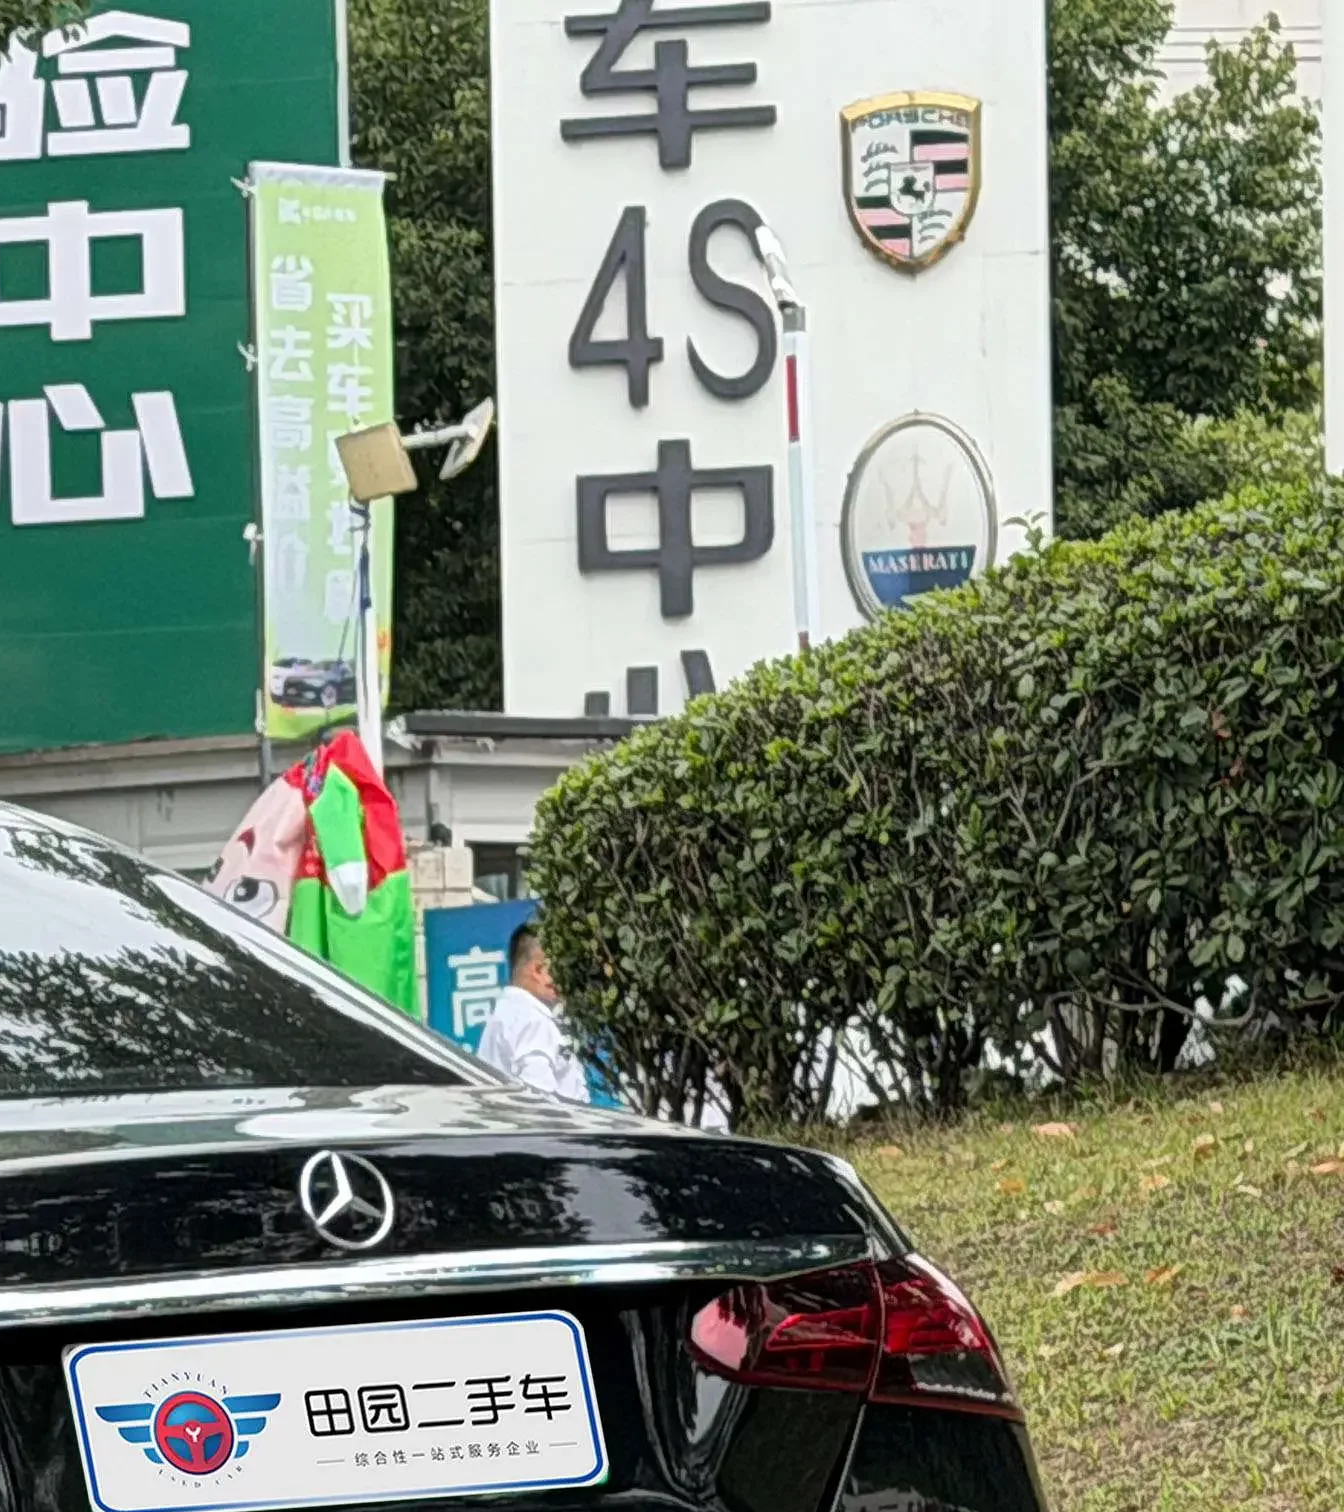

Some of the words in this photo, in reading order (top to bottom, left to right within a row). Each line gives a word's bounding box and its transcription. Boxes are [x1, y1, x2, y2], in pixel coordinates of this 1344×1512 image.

[850, 108, 969, 133] PORSCHE
[867, 551, 969, 574] MASERATI
[304, 1374, 572, 1437] 田园二手车
[354, 1440, 540, 1468] 综合性一站式服务企业
